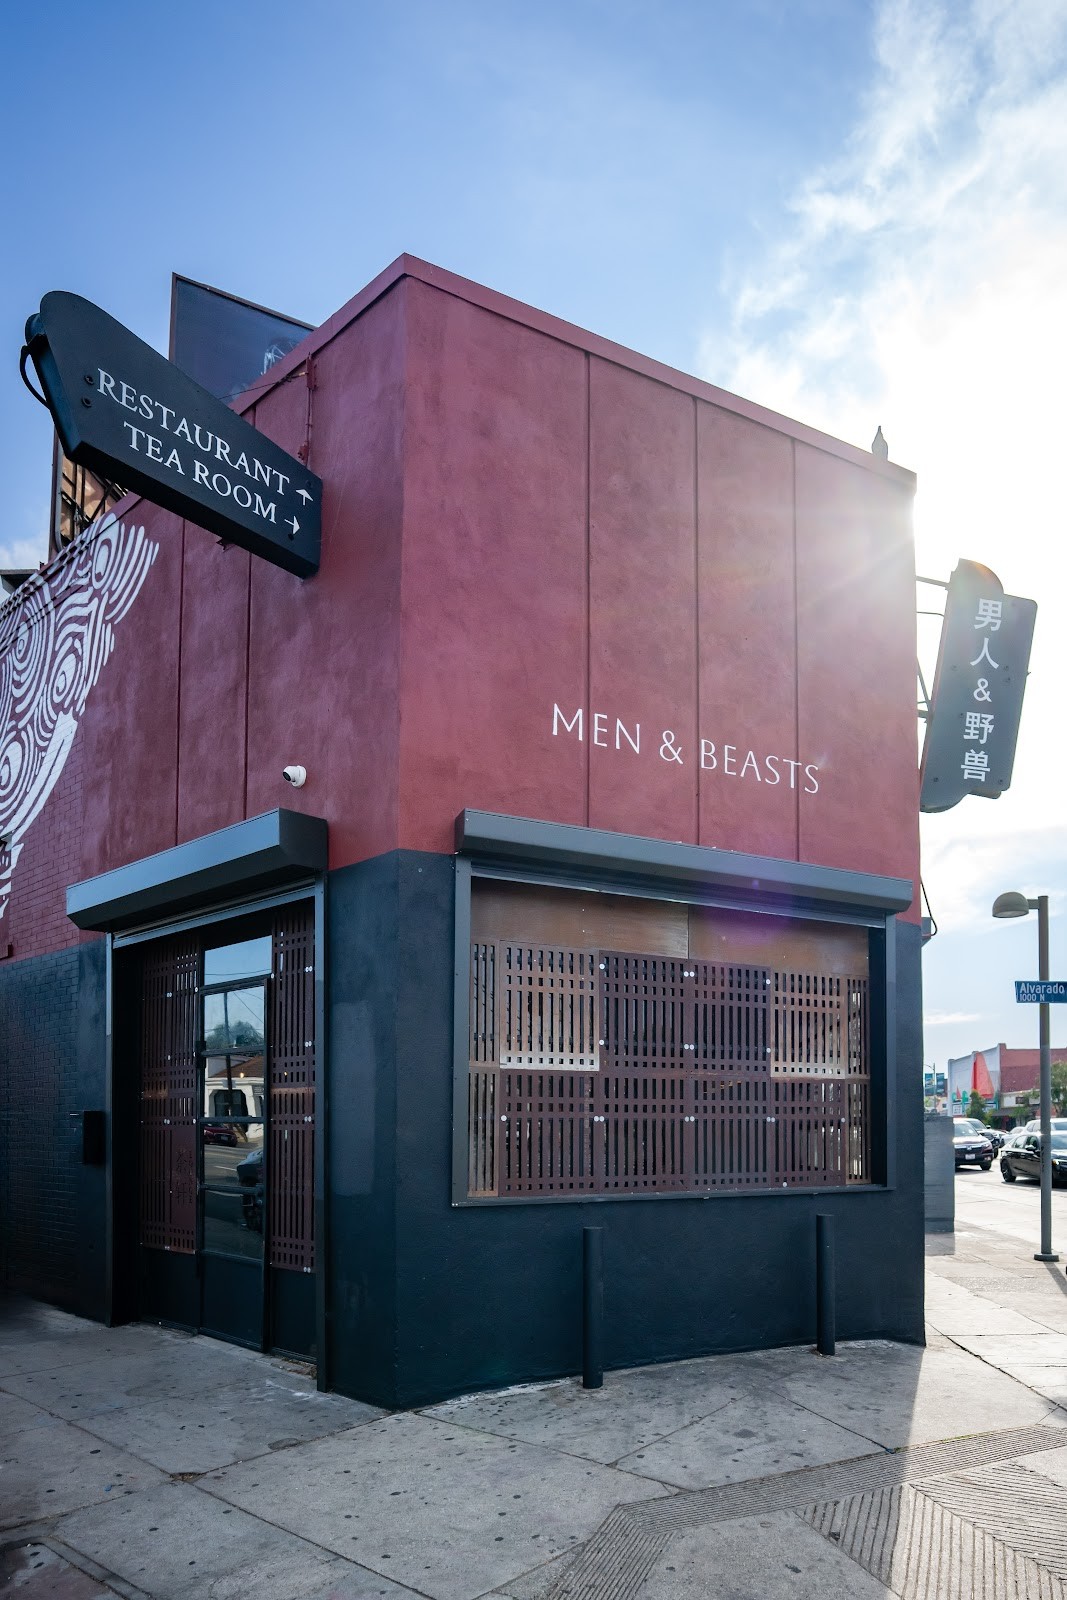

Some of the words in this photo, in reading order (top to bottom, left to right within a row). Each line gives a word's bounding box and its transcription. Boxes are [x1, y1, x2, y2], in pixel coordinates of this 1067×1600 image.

[97, 368, 290, 496] RESTAURANT
[123, 421, 186, 476] TEA
[192, 459, 277, 524] ROOM
[552, 703, 640, 755] MEN
[659, 730, 684, 765] &
[700, 738, 820, 794] BEASTS
[1020, 983, 1064, 993] Alvarado
